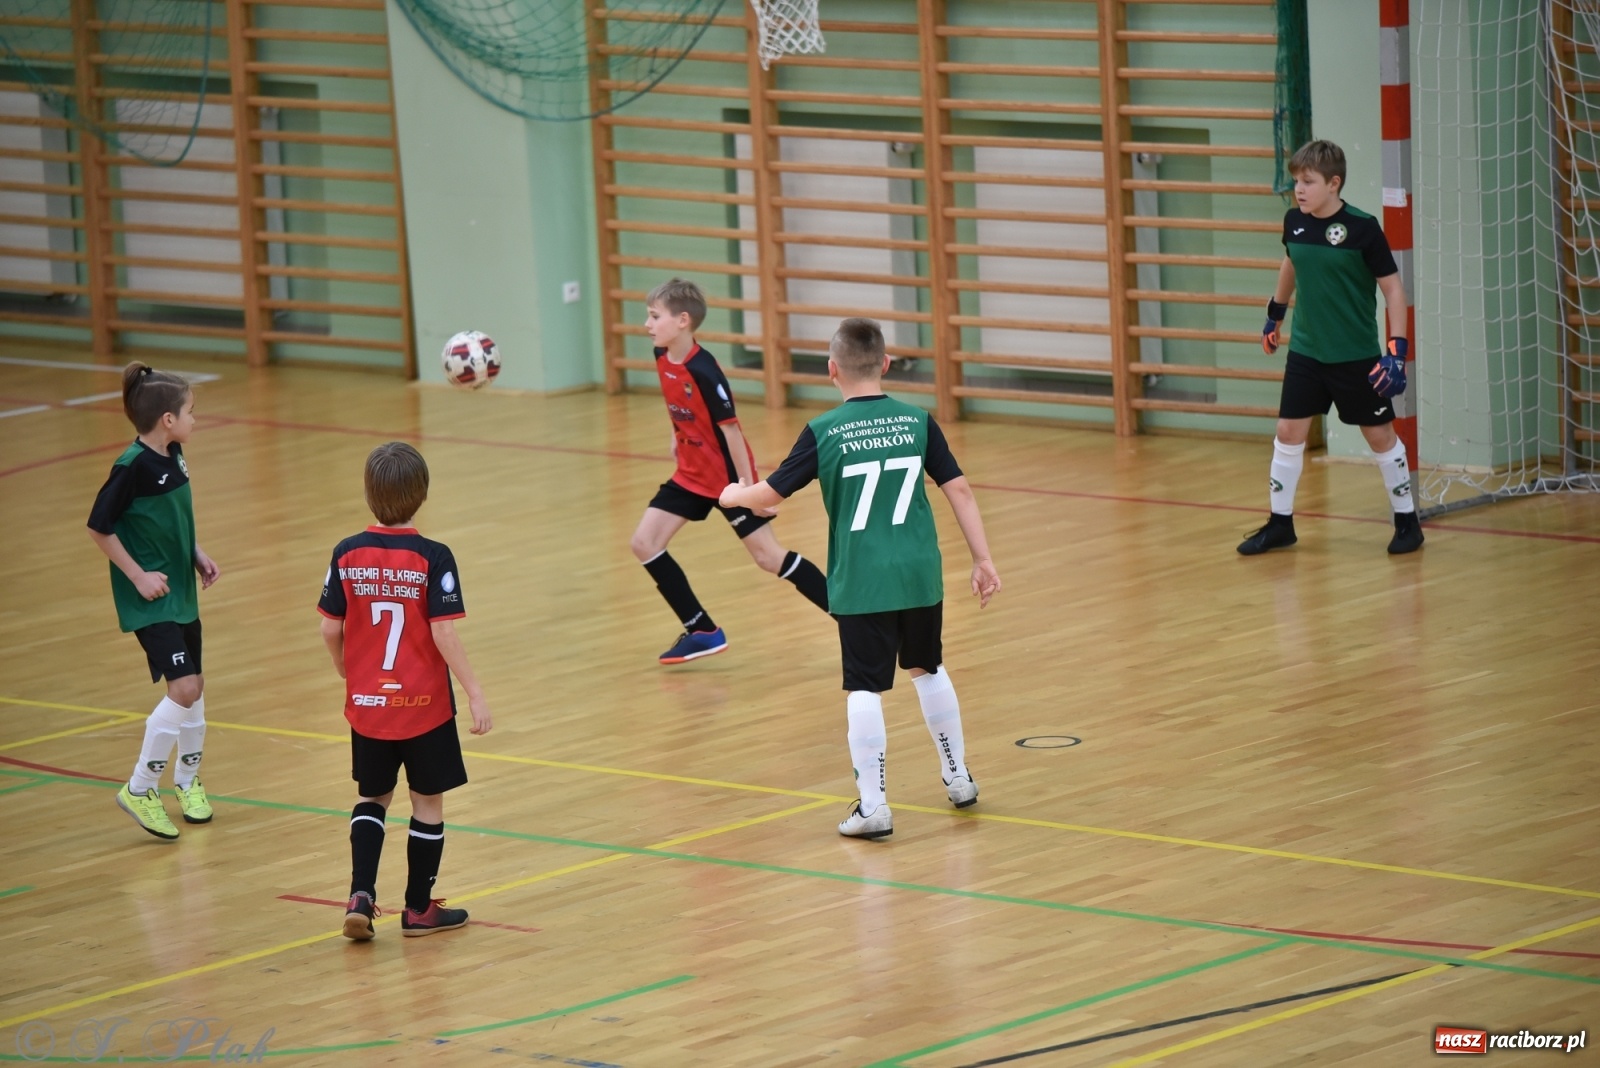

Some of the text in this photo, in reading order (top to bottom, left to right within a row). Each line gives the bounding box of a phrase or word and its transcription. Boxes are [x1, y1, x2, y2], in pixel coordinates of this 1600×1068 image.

[827, 415, 919, 436] AKADEMIA PIŁKARSKA
[842, 424, 909, 440] MŁODEGO LKS-u
[839, 432, 915, 454] TWORKÓW
[842, 456, 922, 531] 77
[352, 580, 379, 596] GÓRKI
[370, 601, 405, 671] 7
[352, 694, 432, 707] GER-BUD
